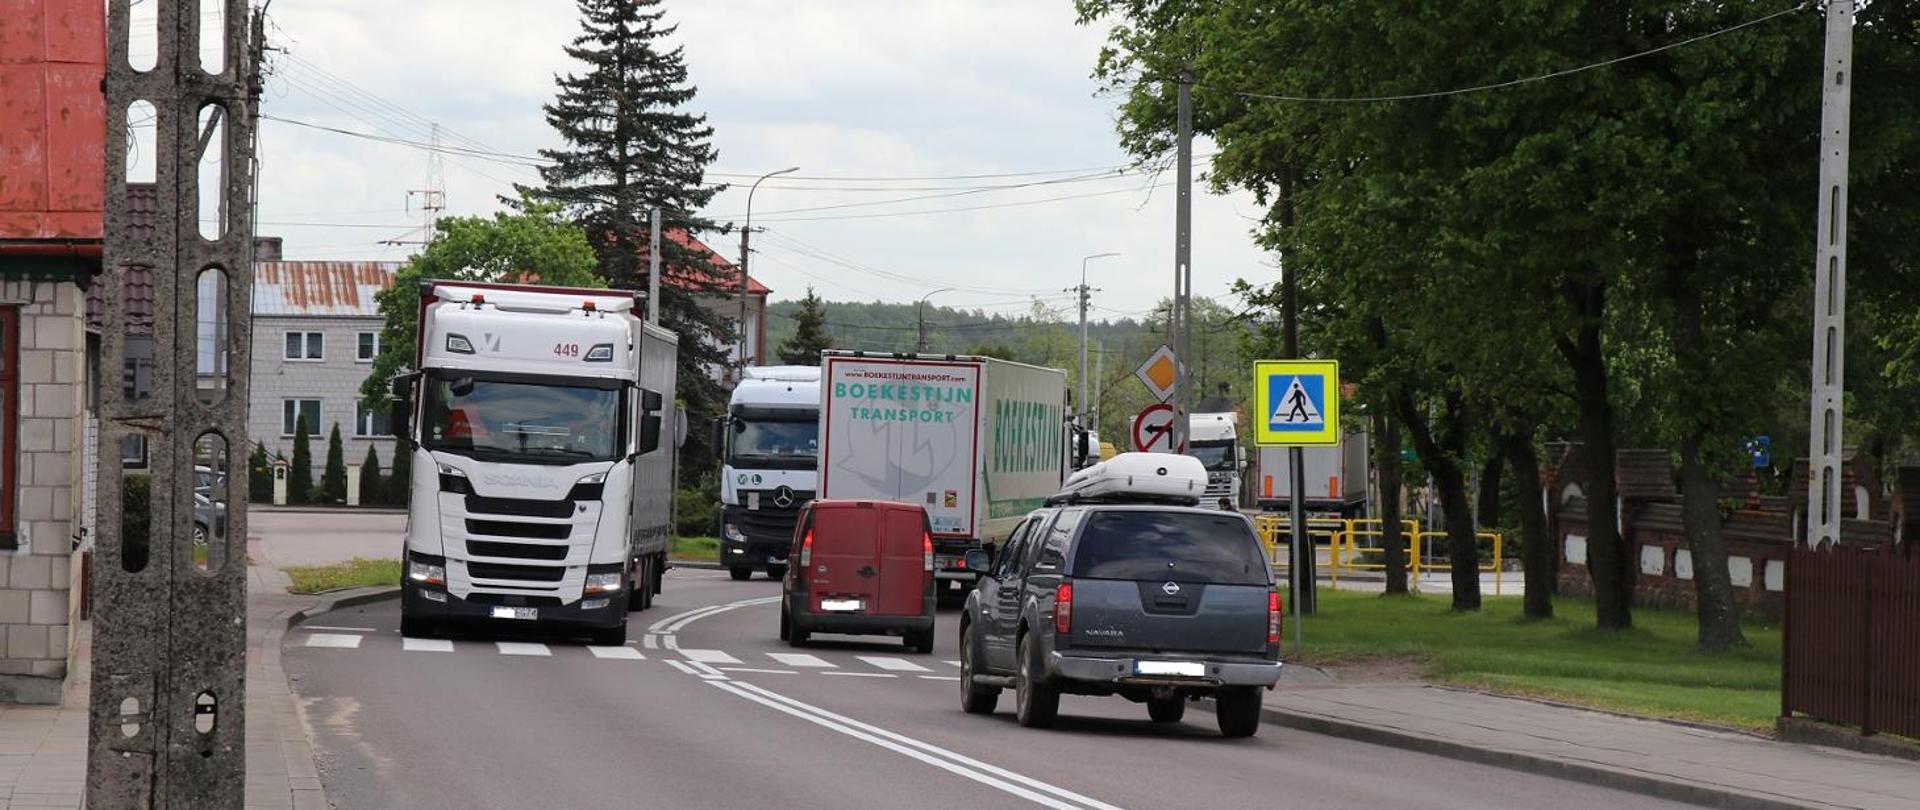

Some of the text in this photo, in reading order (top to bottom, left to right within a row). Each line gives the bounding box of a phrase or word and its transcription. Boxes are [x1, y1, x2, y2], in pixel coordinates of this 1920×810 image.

[554, 343, 579, 357] 449
[835, 382, 972, 402] BOEKESTIJN
[850, 406, 954, 423] TRANSPORT
[994, 399, 1060, 473] BOEKESTIJN
[1085, 629, 1124, 637] NAVARA
